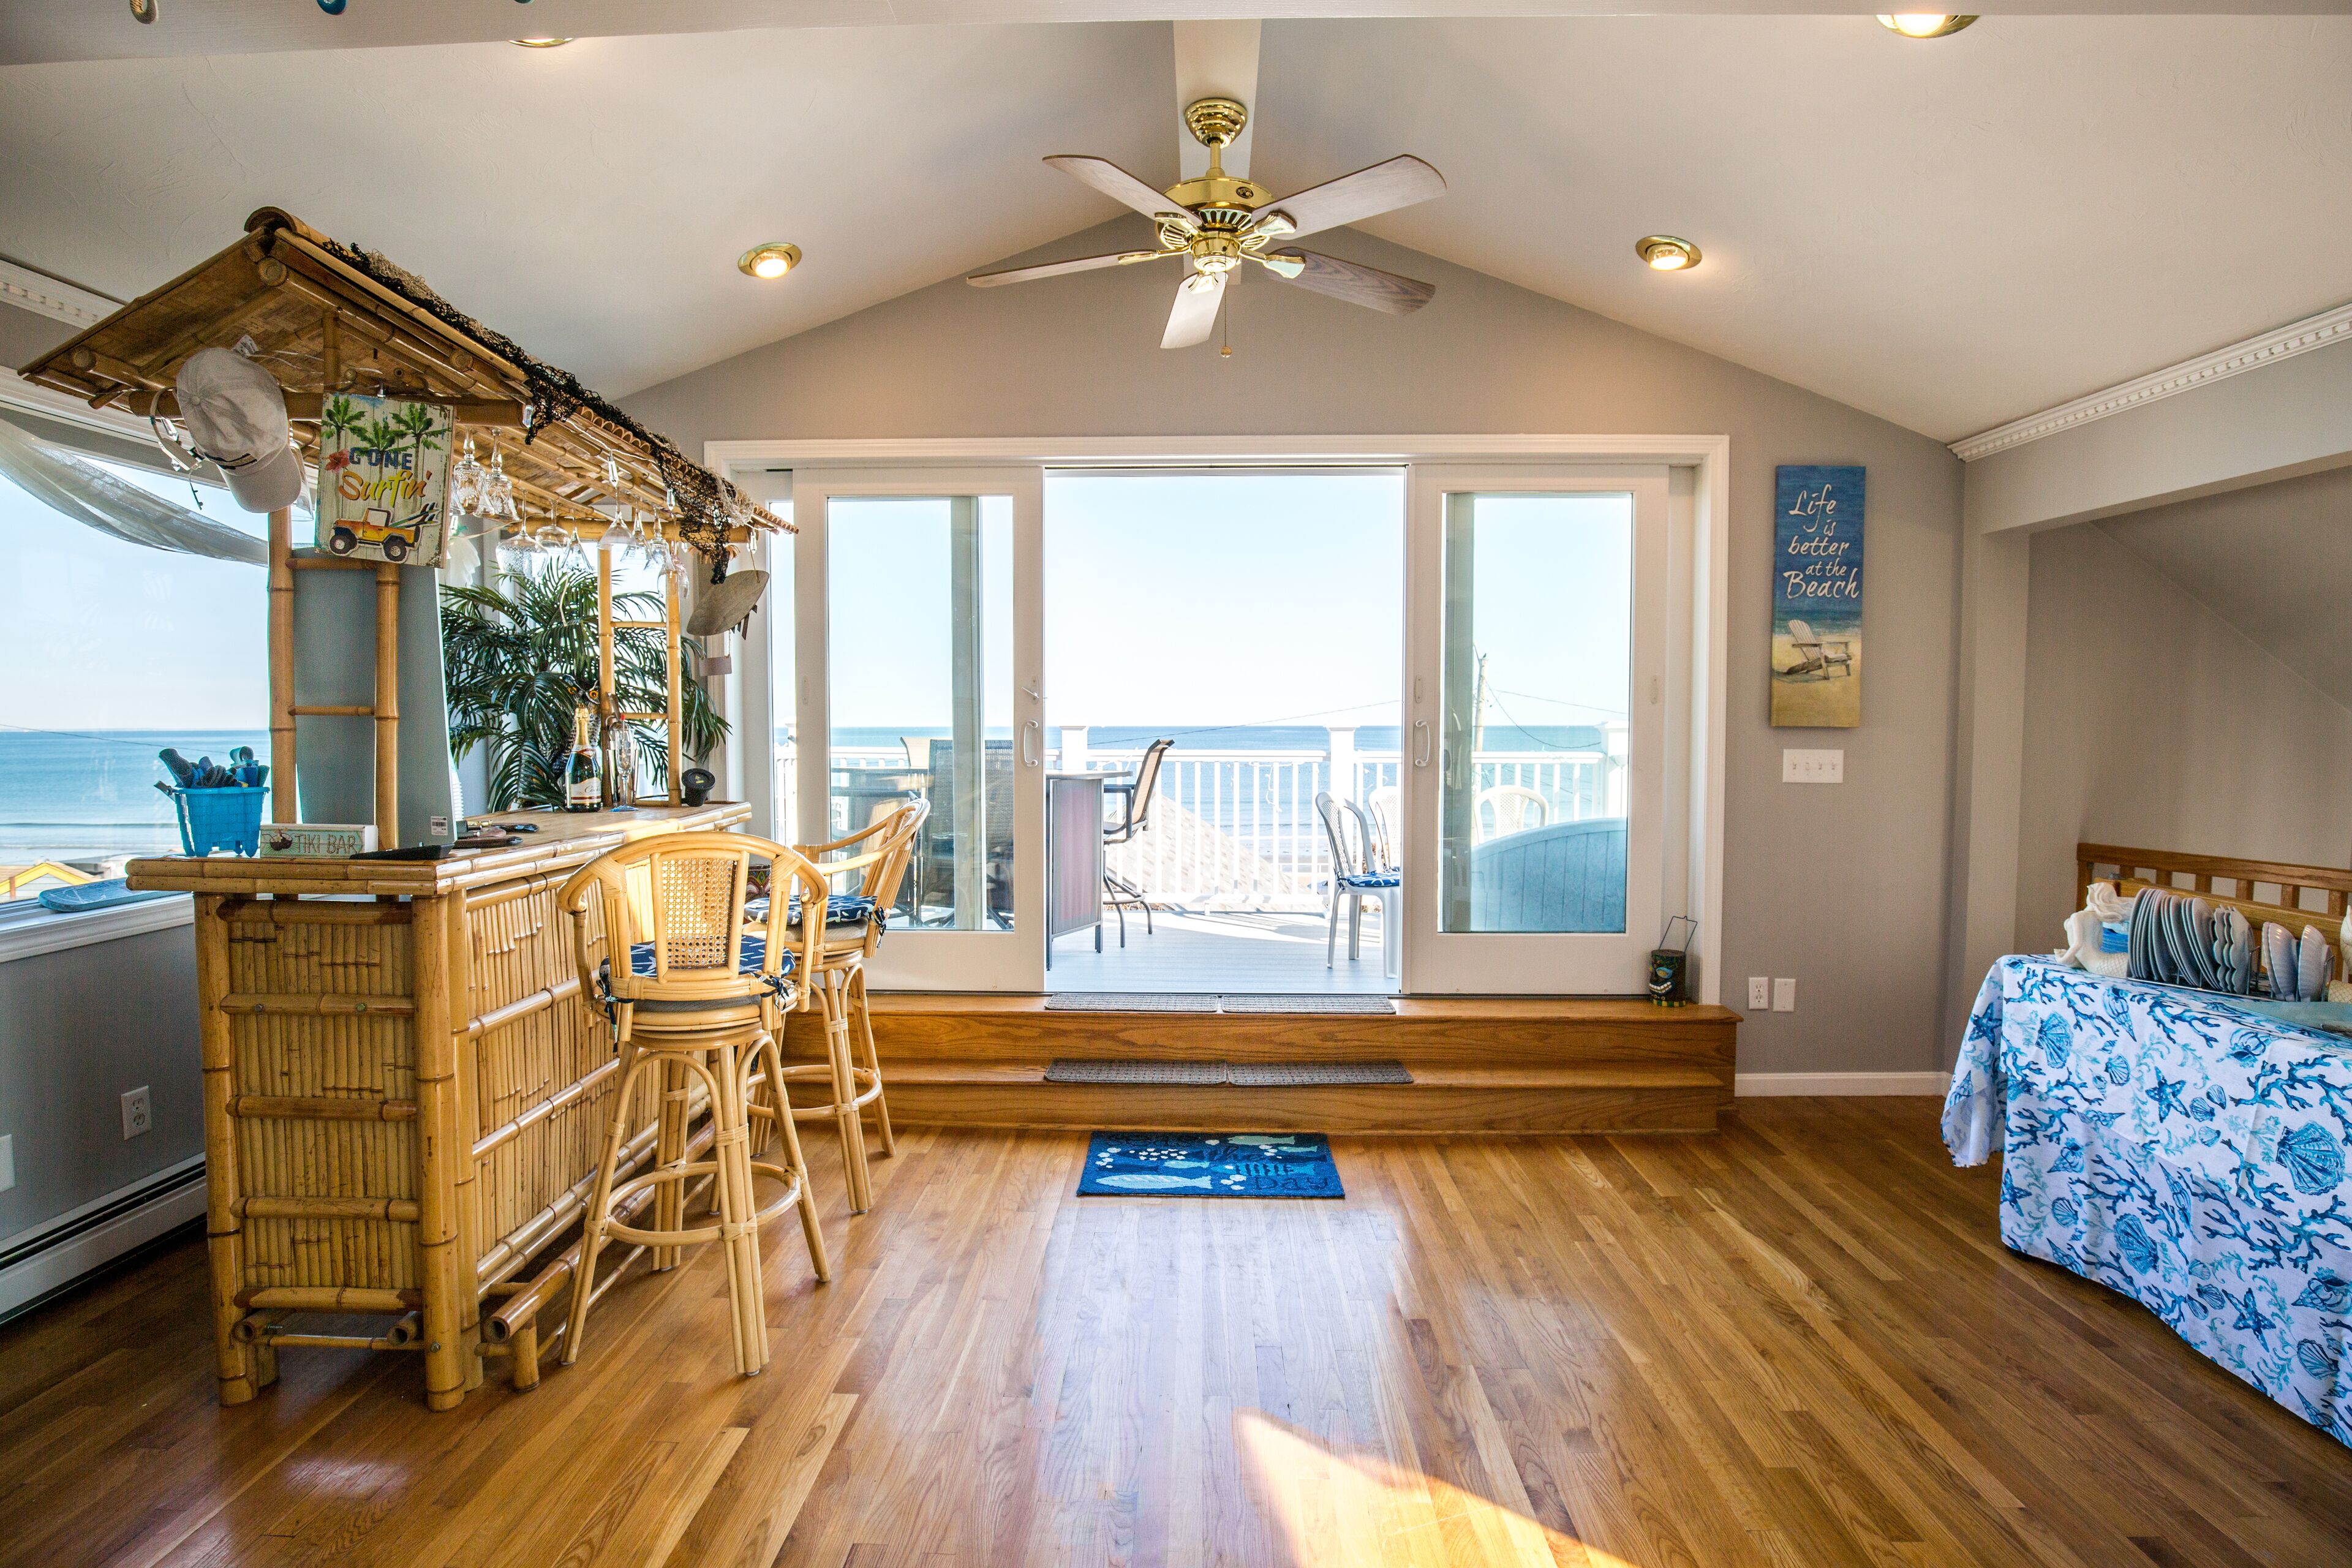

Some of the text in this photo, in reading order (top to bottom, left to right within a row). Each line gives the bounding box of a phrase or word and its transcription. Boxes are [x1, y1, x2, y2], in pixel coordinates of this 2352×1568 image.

[349, 447, 412, 470] GONE
[339, 470, 432, 508] Surfin'
[1789, 484, 1836, 532] Life
[1823, 519, 1836, 536] is
[1787, 535, 1849, 556] better
[1805, 558, 1847, 576] at the
[1783, 568, 1859, 599] Beach
[294, 834, 358, 854] TIKI BAR
